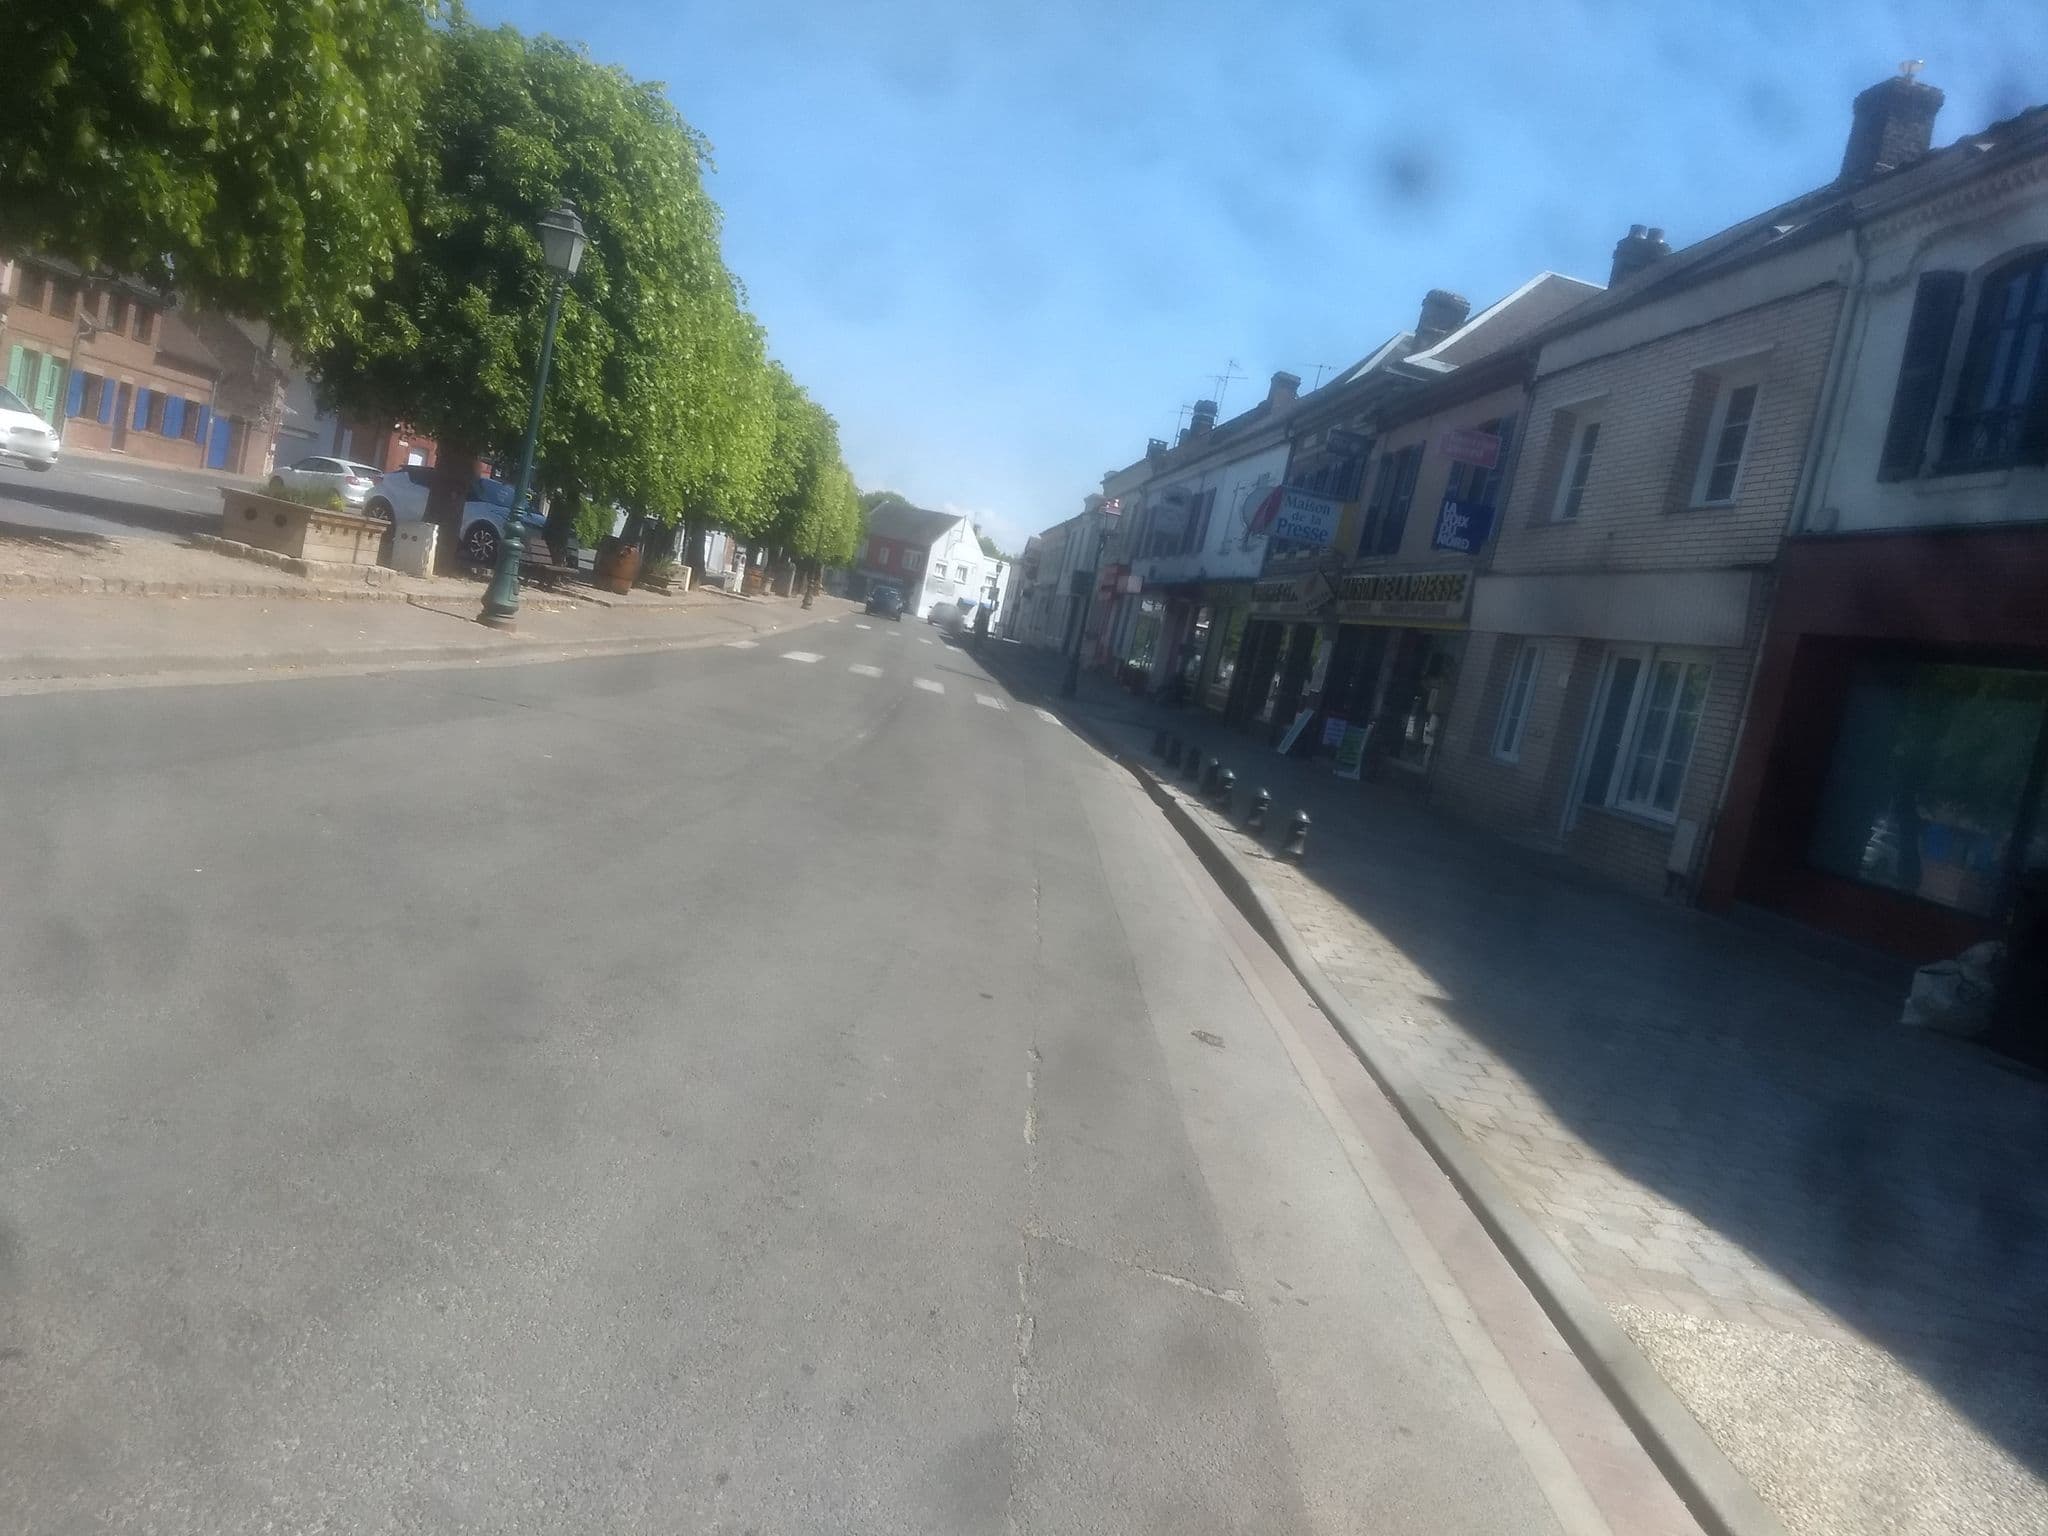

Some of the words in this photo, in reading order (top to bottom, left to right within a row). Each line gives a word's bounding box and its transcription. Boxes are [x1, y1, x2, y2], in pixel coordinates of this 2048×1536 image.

[1285, 495, 1331, 515] Maison
[1444, 501, 1457, 513] LA
[1292, 512, 1306, 522] de
[1311, 514, 1322, 526] la
[1443, 511, 1470, 528] VOIX
[1276, 517, 1329, 542] Presse
[1440, 523, 1457, 536] DU
[1436, 535, 1470, 550] NORD
